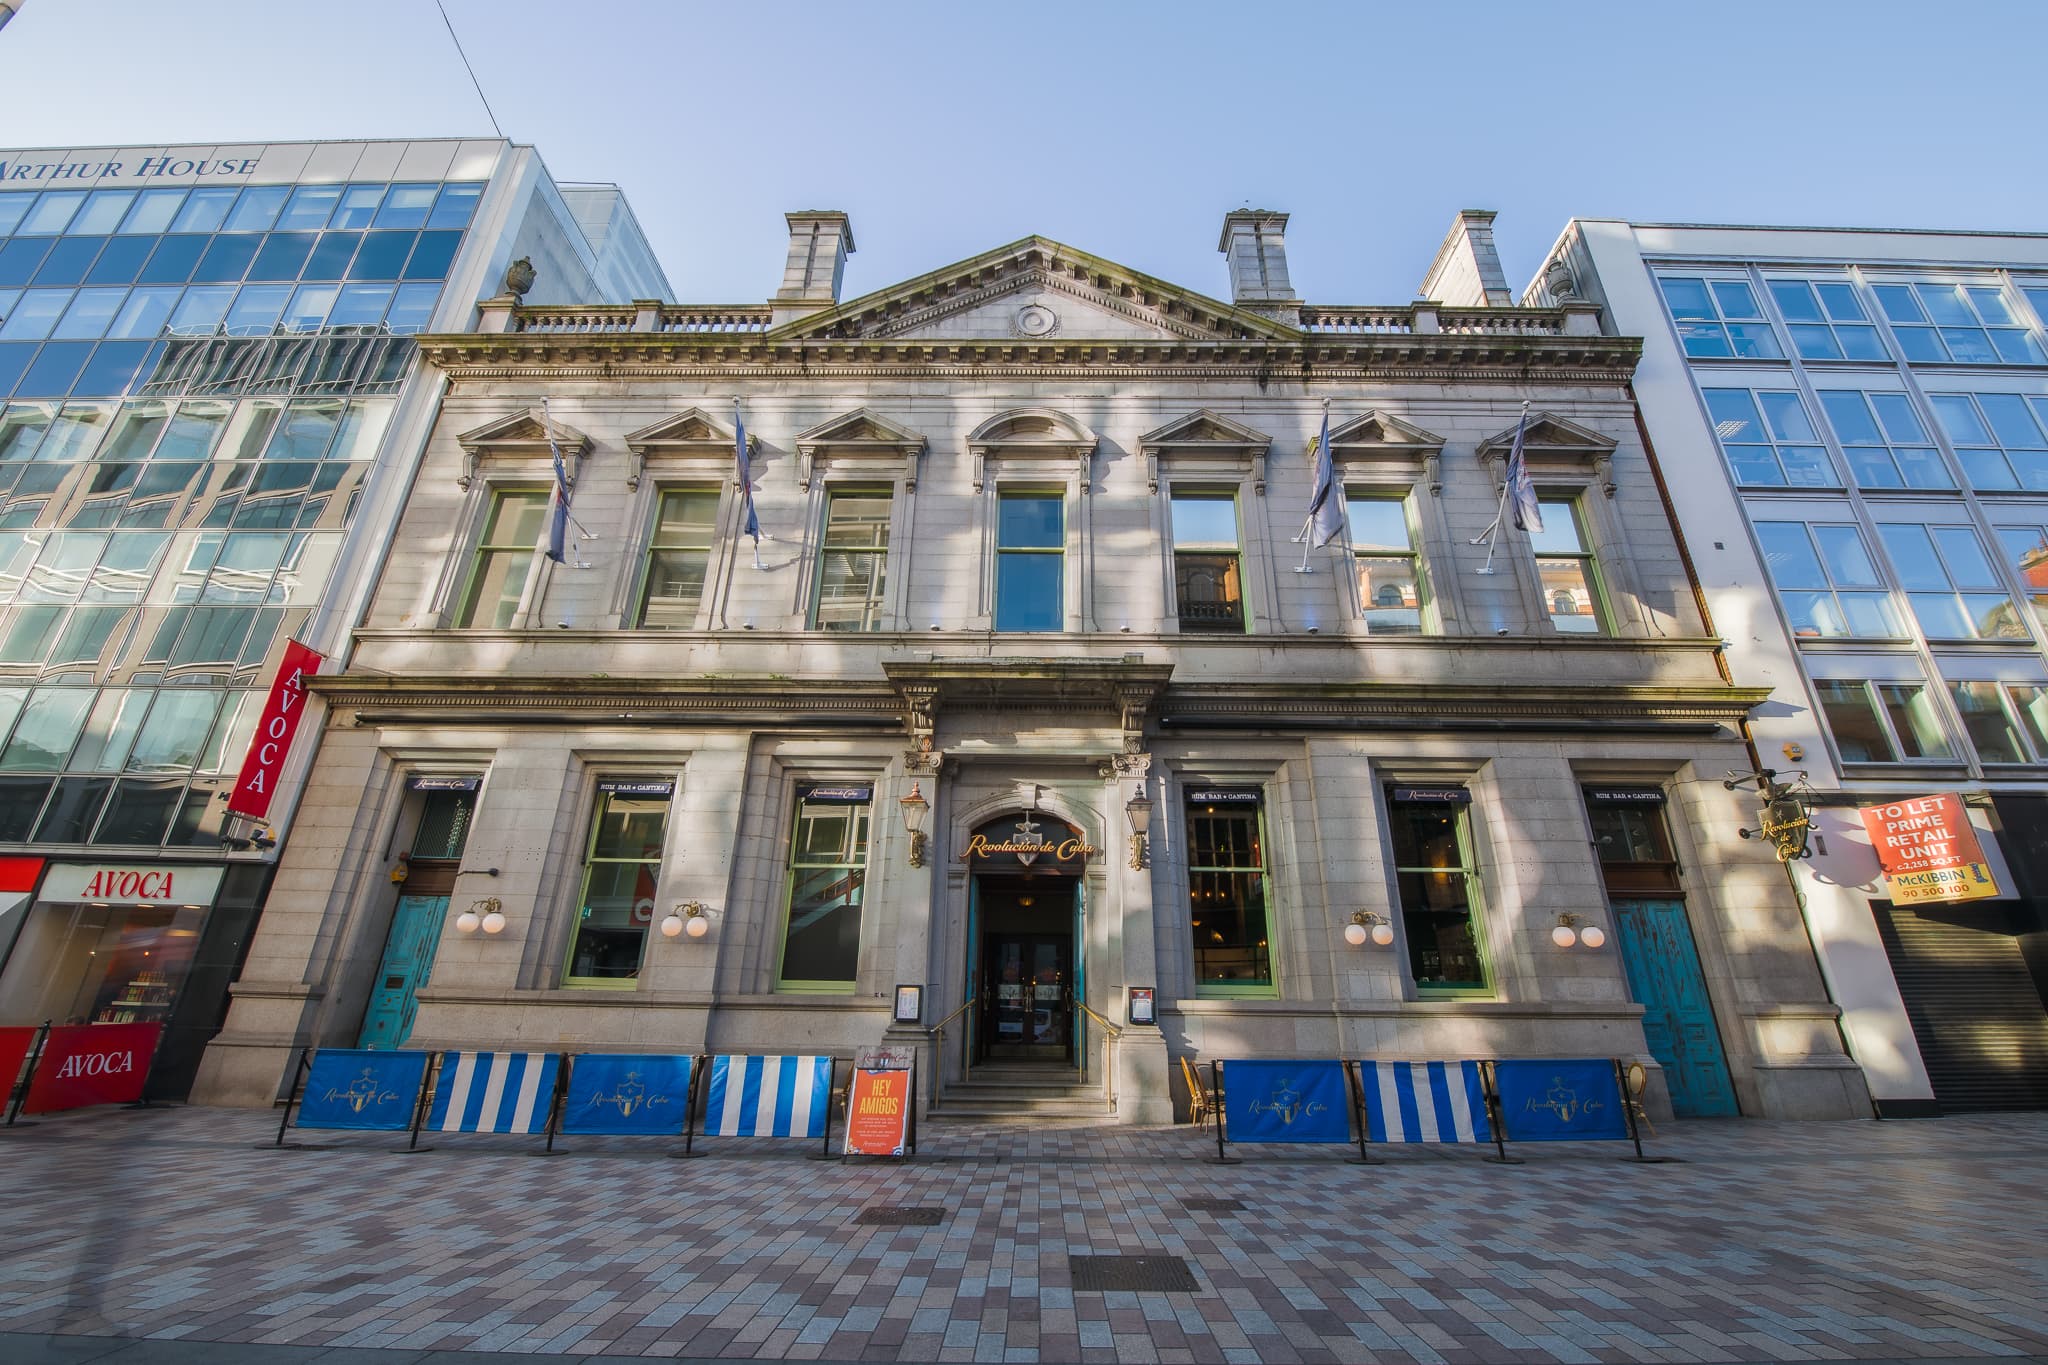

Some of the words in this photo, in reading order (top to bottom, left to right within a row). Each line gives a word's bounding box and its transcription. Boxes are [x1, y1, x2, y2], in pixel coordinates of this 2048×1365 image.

[133, 157, 260, 177] HOUSE
[246, 667, 302, 794] AVOCA
[1871, 806, 1903, 821] TO
[1907, 797, 1946, 816] LET
[1761, 817, 1808, 840] Revolución
[1886, 814, 1945, 833] PRIME
[959, 834, 1039, 859] Revolución
[1040, 841, 1056, 853] de
[1056, 838, 1096, 861] Cuba
[1885, 828, 1956, 848] RETAIL
[1776, 843, 1801, 863] Cuba
[1900, 843, 1949, 860] UNIT
[81, 871, 174, 898] AVOCA
[1897, 869, 1966, 886] McKIBBIN
[1903, 889, 1918, 898] 90
[1922, 887, 1945, 896] 500
[1949, 884, 1970, 893] 100
[56, 1051, 132, 1078] AVOCA
[872, 1080, 892, 1096] HEY
[859, 1097, 898, 1114] AMIGOS
